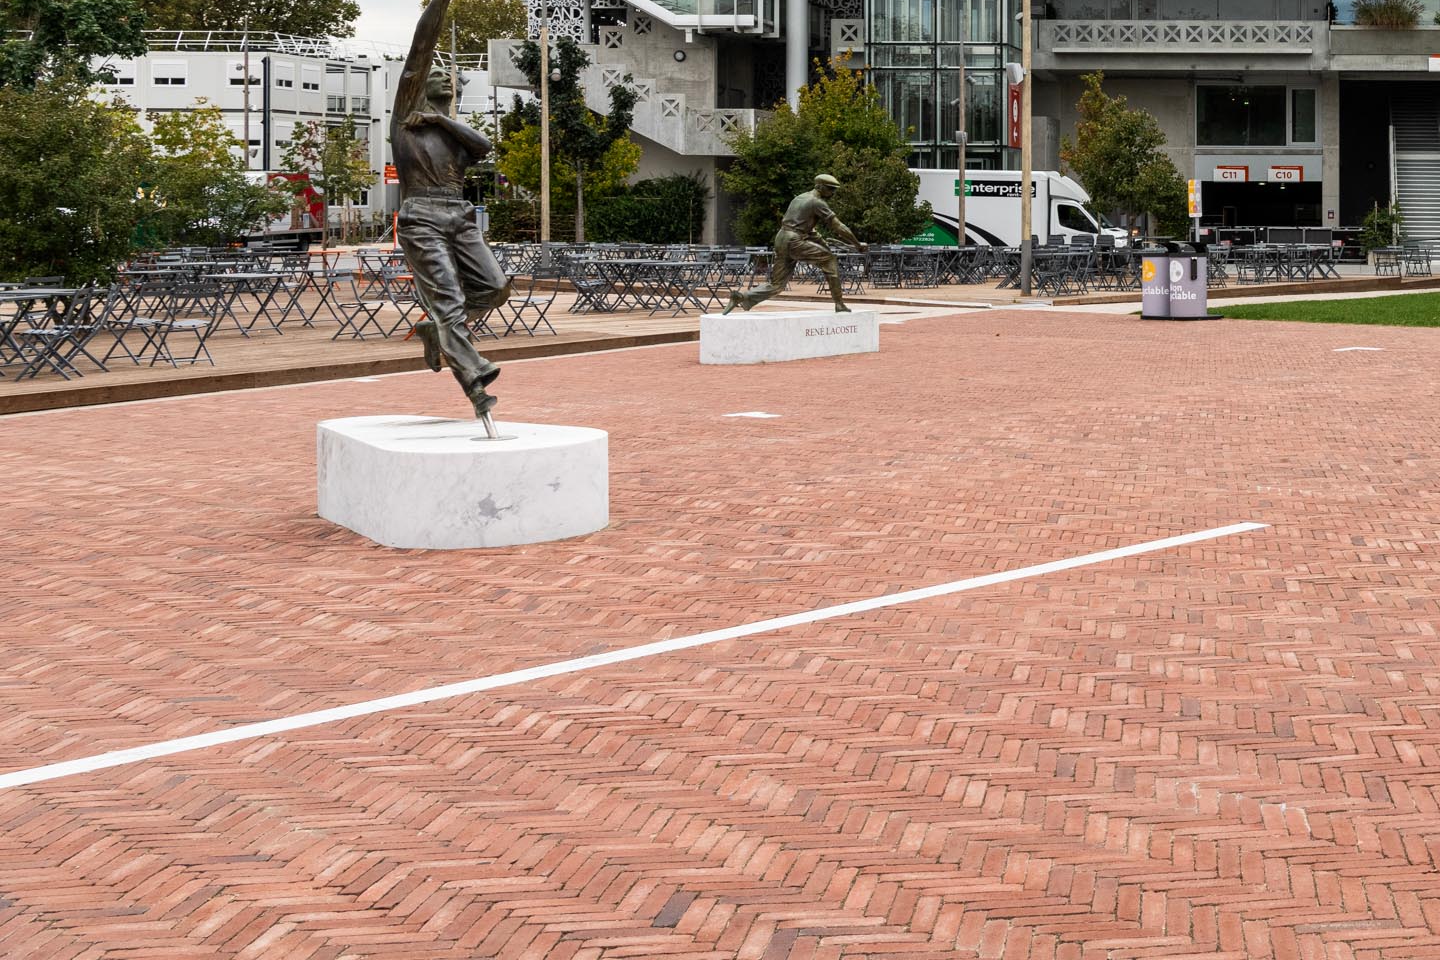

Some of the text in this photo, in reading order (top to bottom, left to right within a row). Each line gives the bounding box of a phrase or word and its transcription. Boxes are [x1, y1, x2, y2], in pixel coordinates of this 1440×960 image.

[1221, 171, 1237, 179] C11
[1275, 171, 1293, 179] C10
[805, 324, 858, 337] RENÉ LACOSTE
